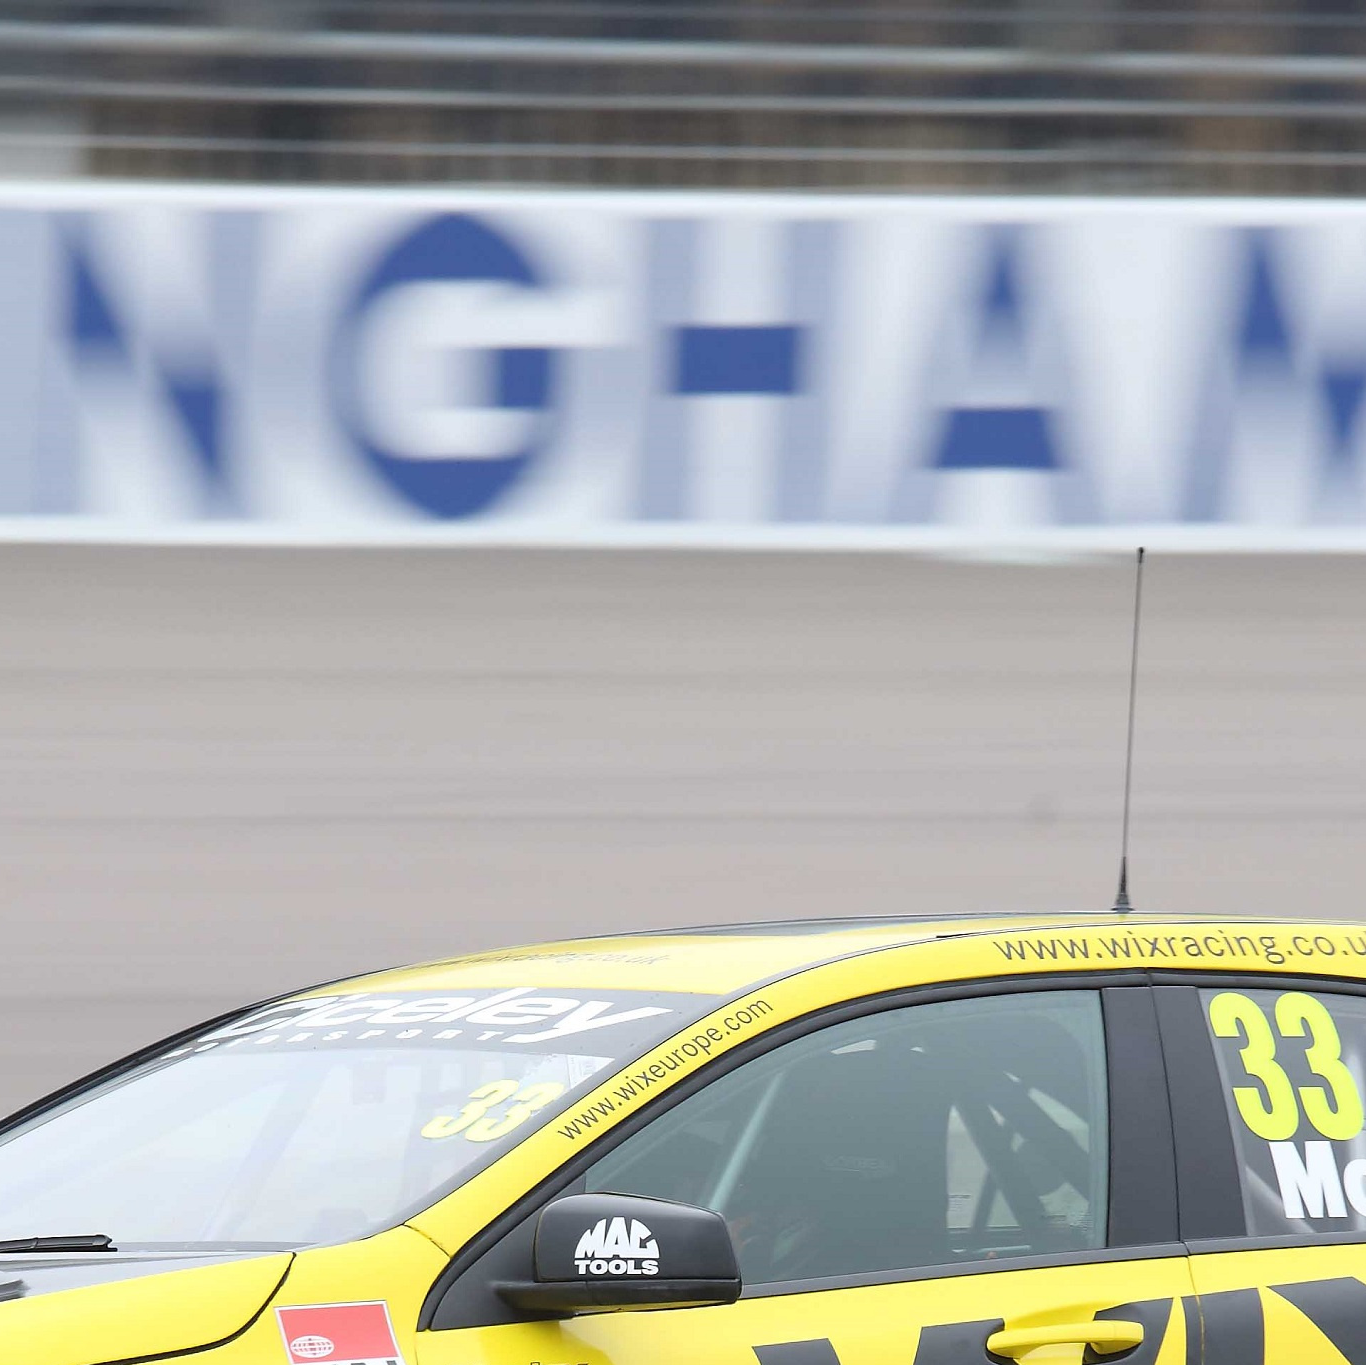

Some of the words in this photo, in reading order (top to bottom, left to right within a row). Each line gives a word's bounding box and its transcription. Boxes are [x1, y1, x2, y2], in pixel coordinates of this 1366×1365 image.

[197, 986, 674, 1044] Ciceley
[556, 999, 774, 1140] www.wixeurope.com
[1210, 992, 1364, 1141] 33
[421, 1079, 566, 1142] 33
[574, 1216, 660, 1259] MAC
[574, 1260, 660, 1276] TOOLS
